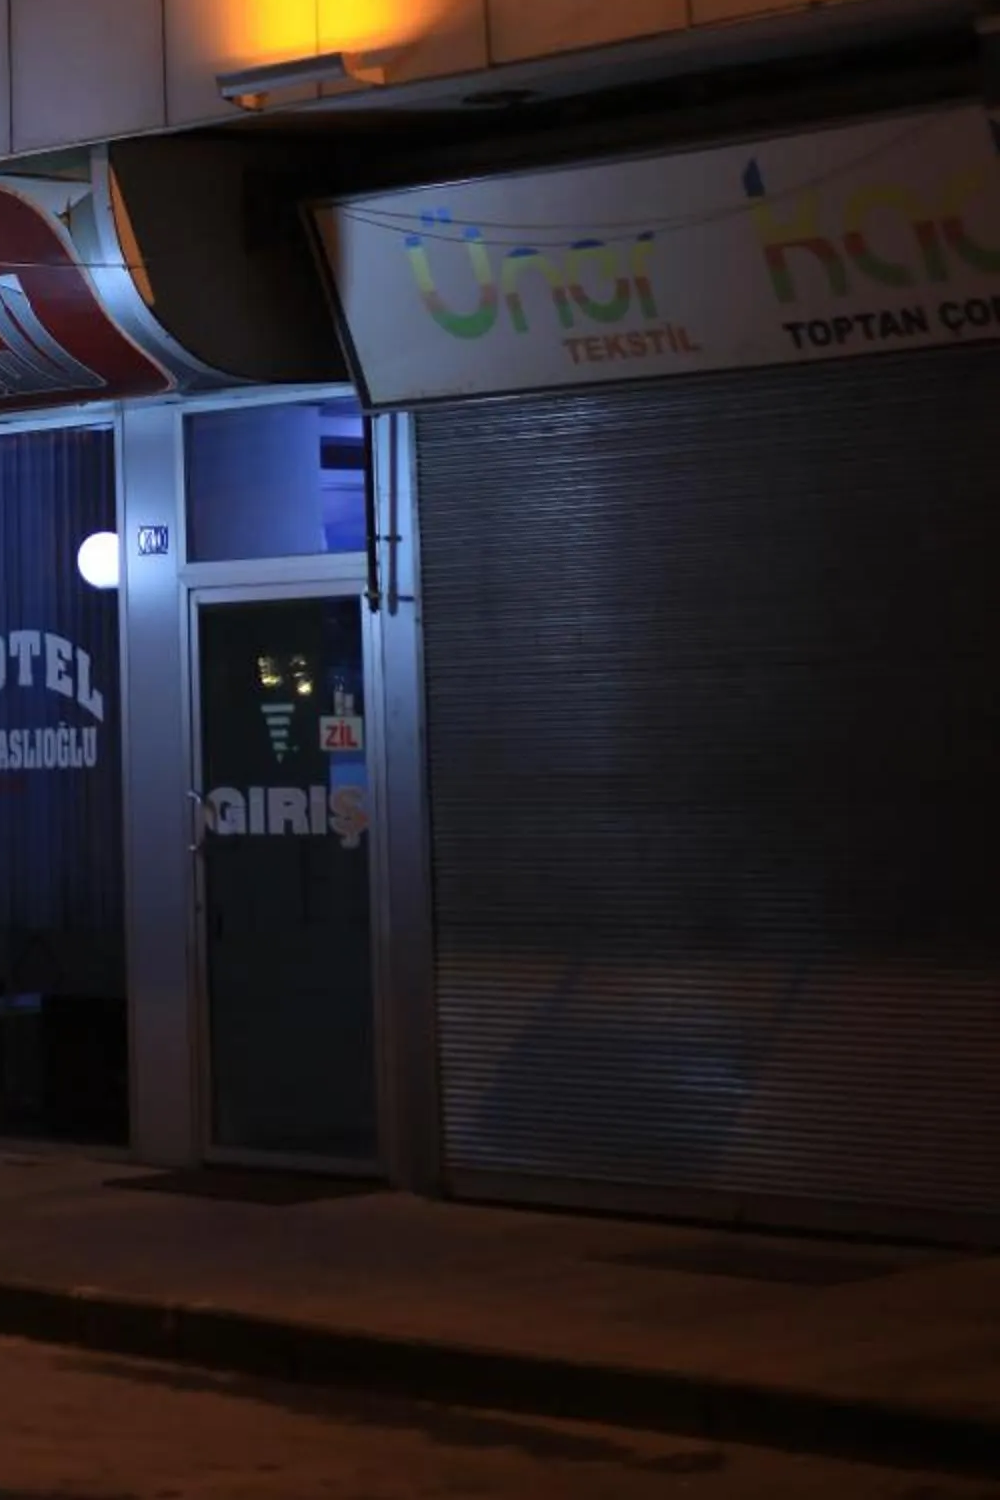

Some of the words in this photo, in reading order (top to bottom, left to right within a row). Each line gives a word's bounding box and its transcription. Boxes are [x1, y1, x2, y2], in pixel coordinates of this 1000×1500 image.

[561, 322, 703, 366] TEKSTİL
[782, 304, 930, 350] TOPTAN
[324, 719, 359, 748] ZİL
